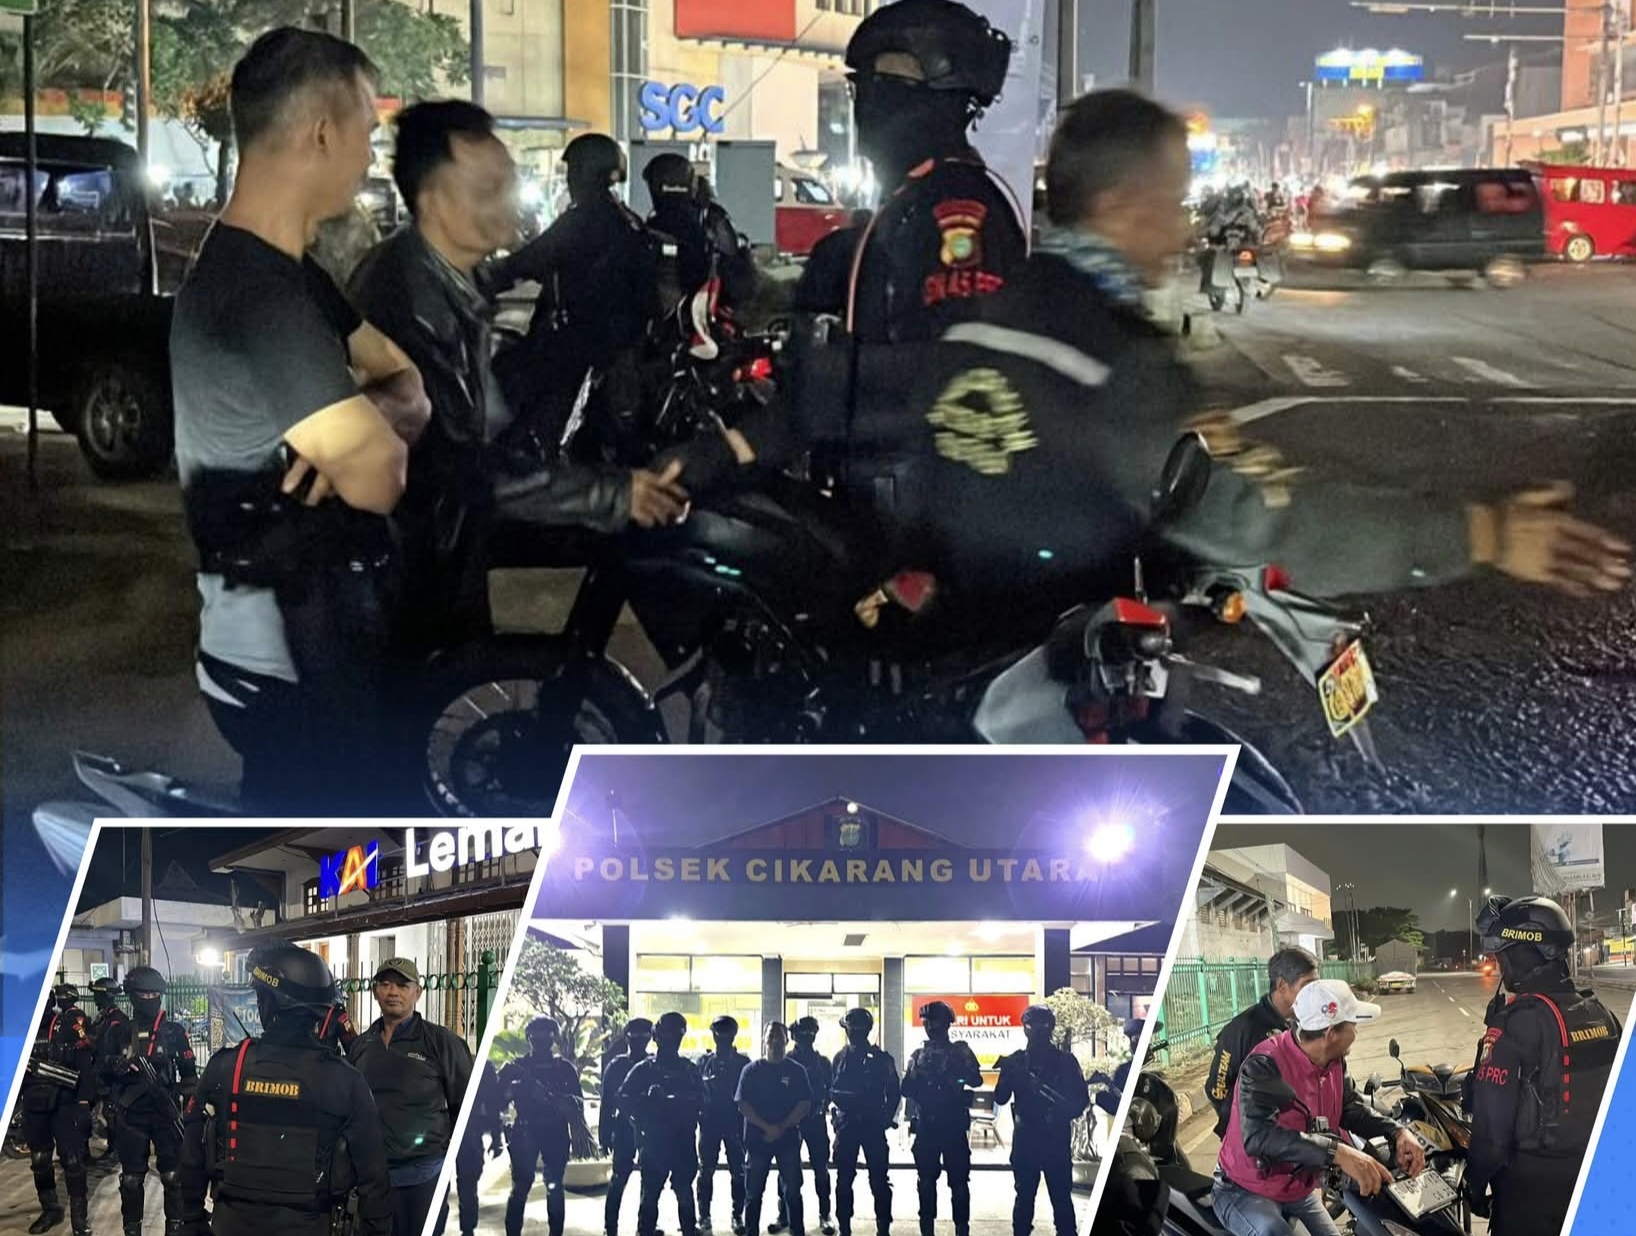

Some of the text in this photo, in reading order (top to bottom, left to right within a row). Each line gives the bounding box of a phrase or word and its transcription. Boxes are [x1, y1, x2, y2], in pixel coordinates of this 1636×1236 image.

[638, 81, 724, 133] SGC
[320, 827, 542, 898] KAI Lema
[573, 857, 1100, 883] POLSEK CIKARANG UTARA
[1501, 927, 1543, 942] BRIMOB
[252, 965, 280, 988] BRIMOB
[970, 1014, 1012, 1026] UNTUK
[1569, 1025, 1610, 1042] BRIMOB
[1485, 1066, 1509, 1086] PRC
[244, 1079, 300, 1097] BRIMOB
